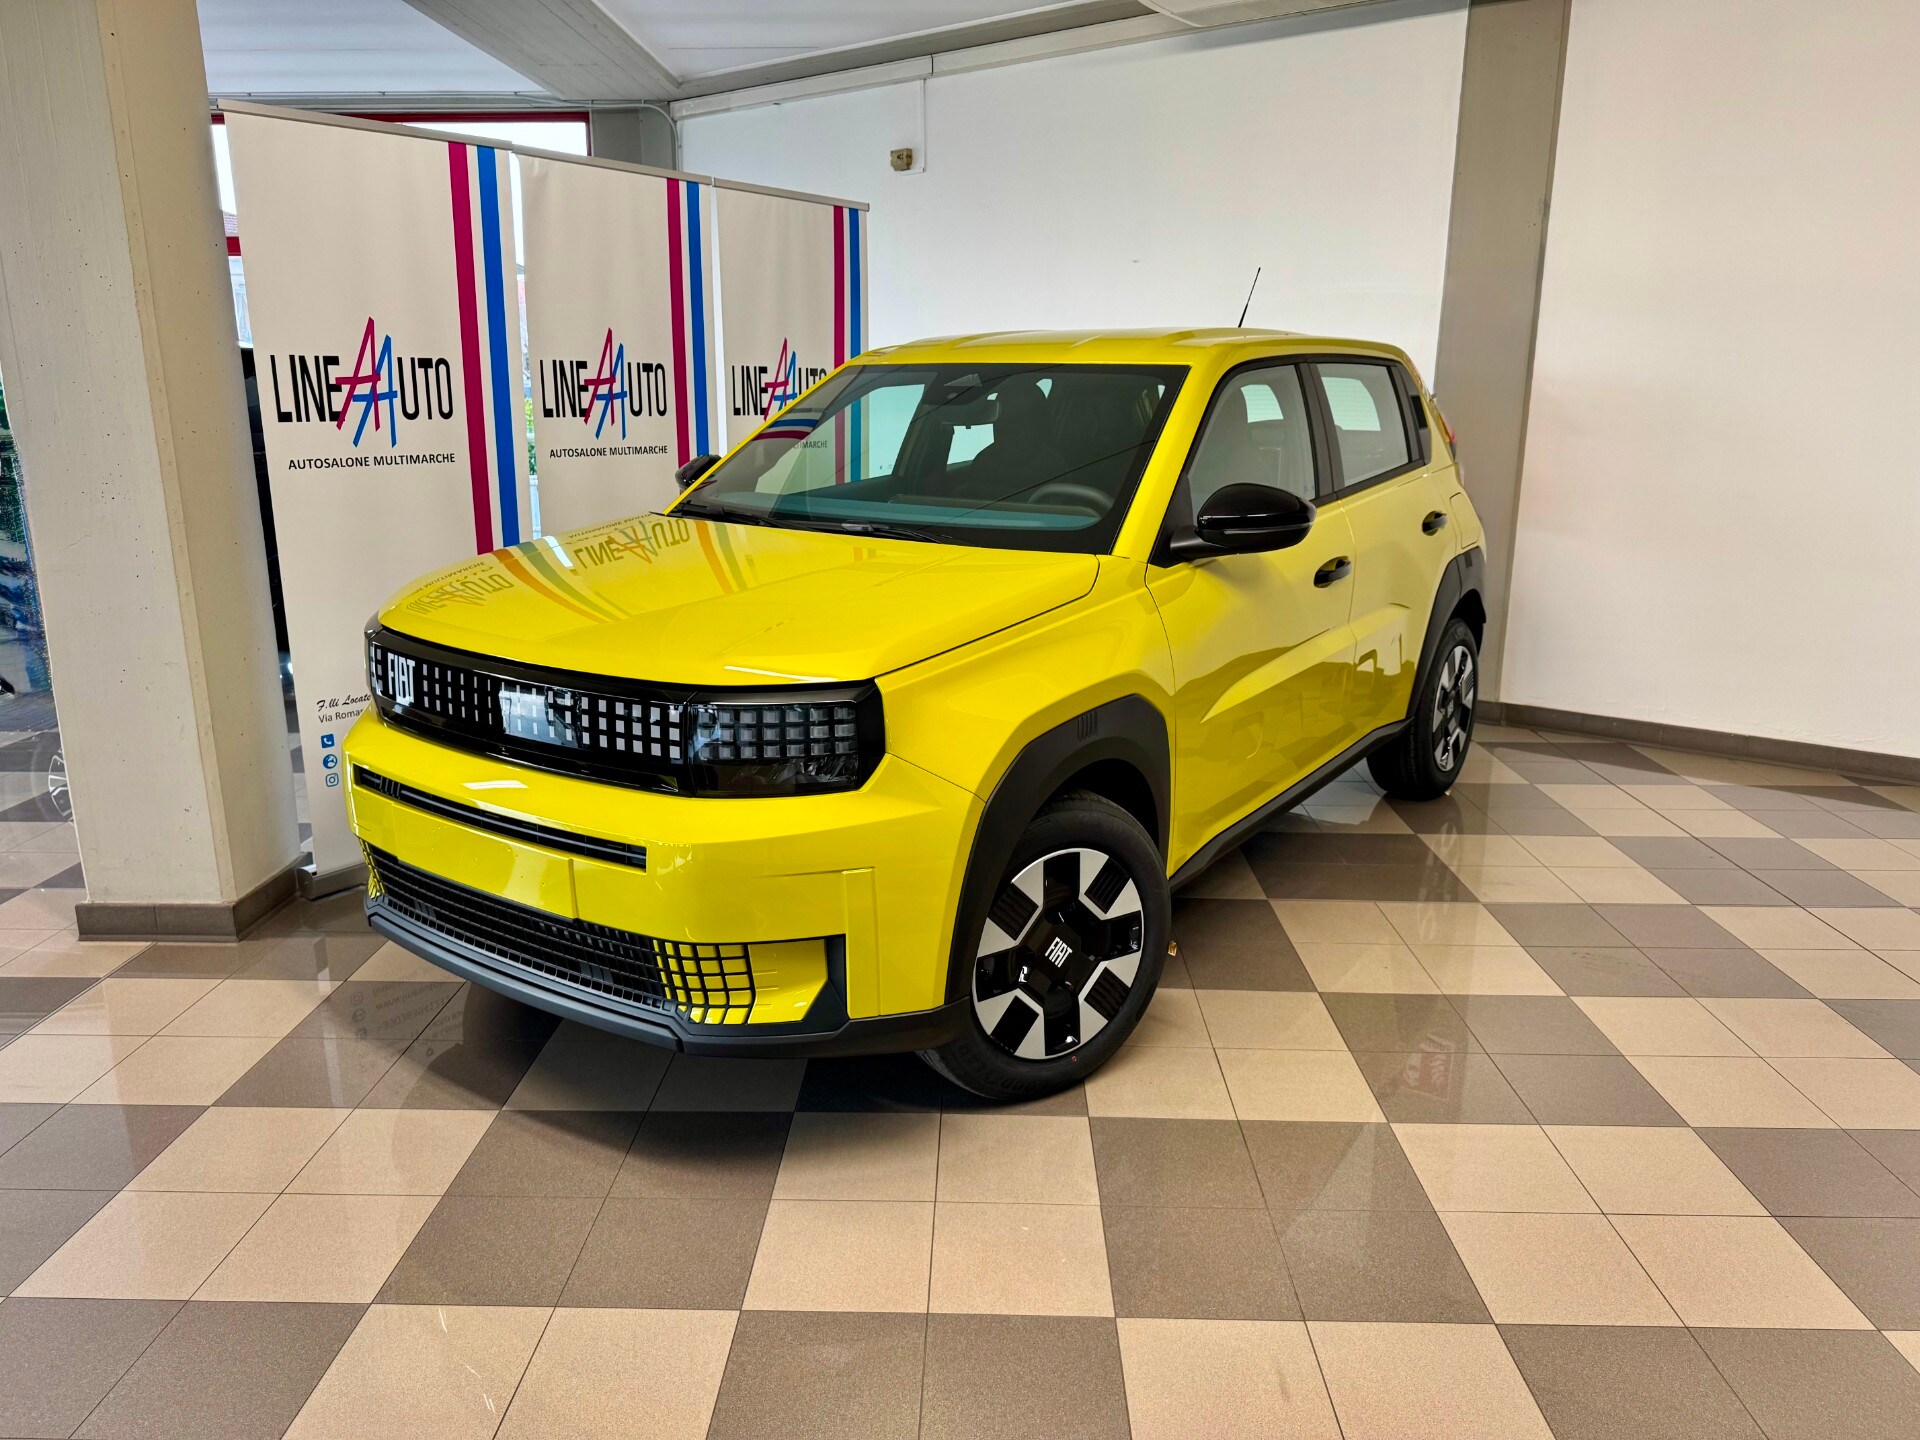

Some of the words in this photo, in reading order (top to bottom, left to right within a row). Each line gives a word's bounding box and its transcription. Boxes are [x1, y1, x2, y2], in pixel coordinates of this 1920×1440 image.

[549, 447, 607, 458] AUTOSALONE
[609, 445, 668, 456] MULTIMARCHE
[288, 456, 370, 470] AUTOSALONE
[373, 453, 456, 466] MULTIMARCHE
[388, 652, 415, 702] FIAT
[318, 713, 333, 723] Via
[1045, 937, 1072, 967] FIAT
